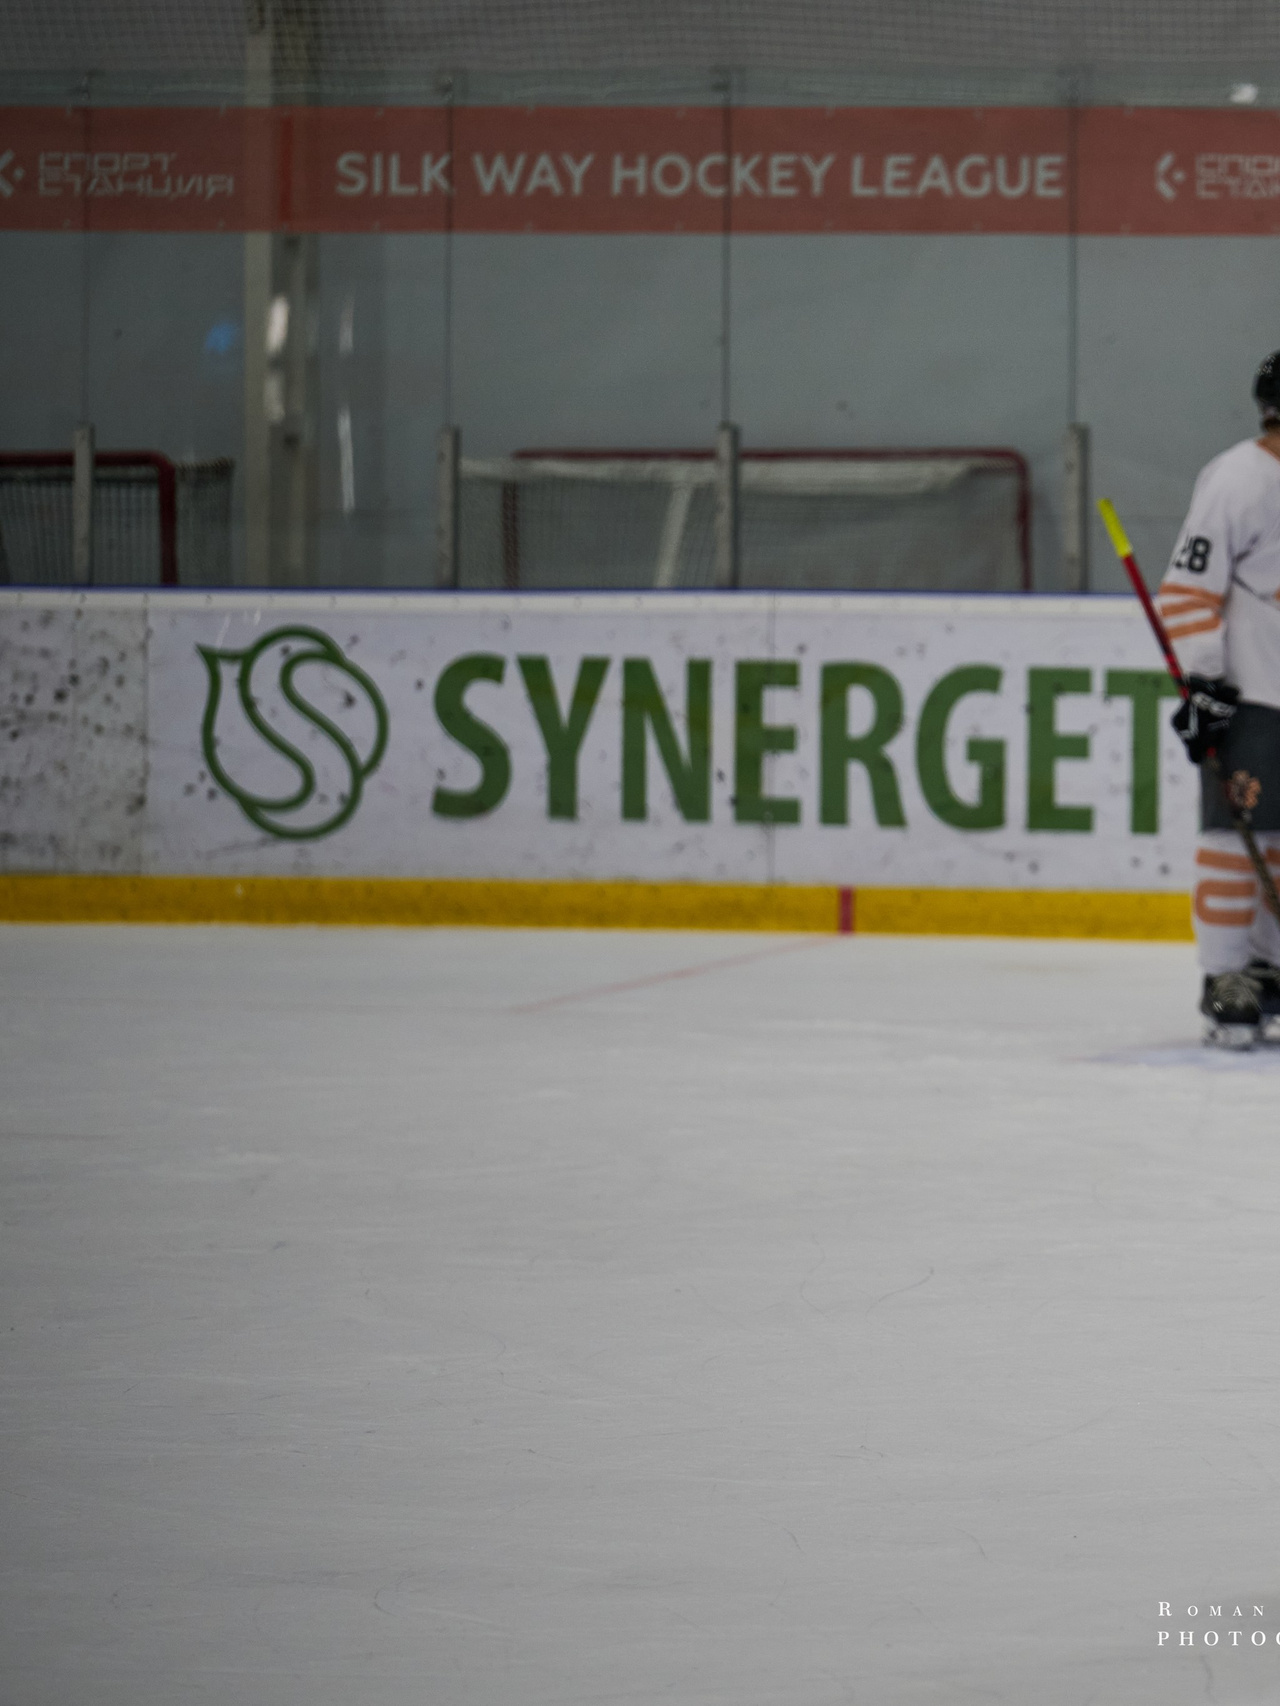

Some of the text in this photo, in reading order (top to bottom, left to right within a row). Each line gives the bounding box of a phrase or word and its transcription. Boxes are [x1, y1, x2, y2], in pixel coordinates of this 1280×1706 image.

[334, 151, 1065, 200] SILK WAY HOCKEY LEAGUE
[432, 652, 1189, 835] SYNERGET
